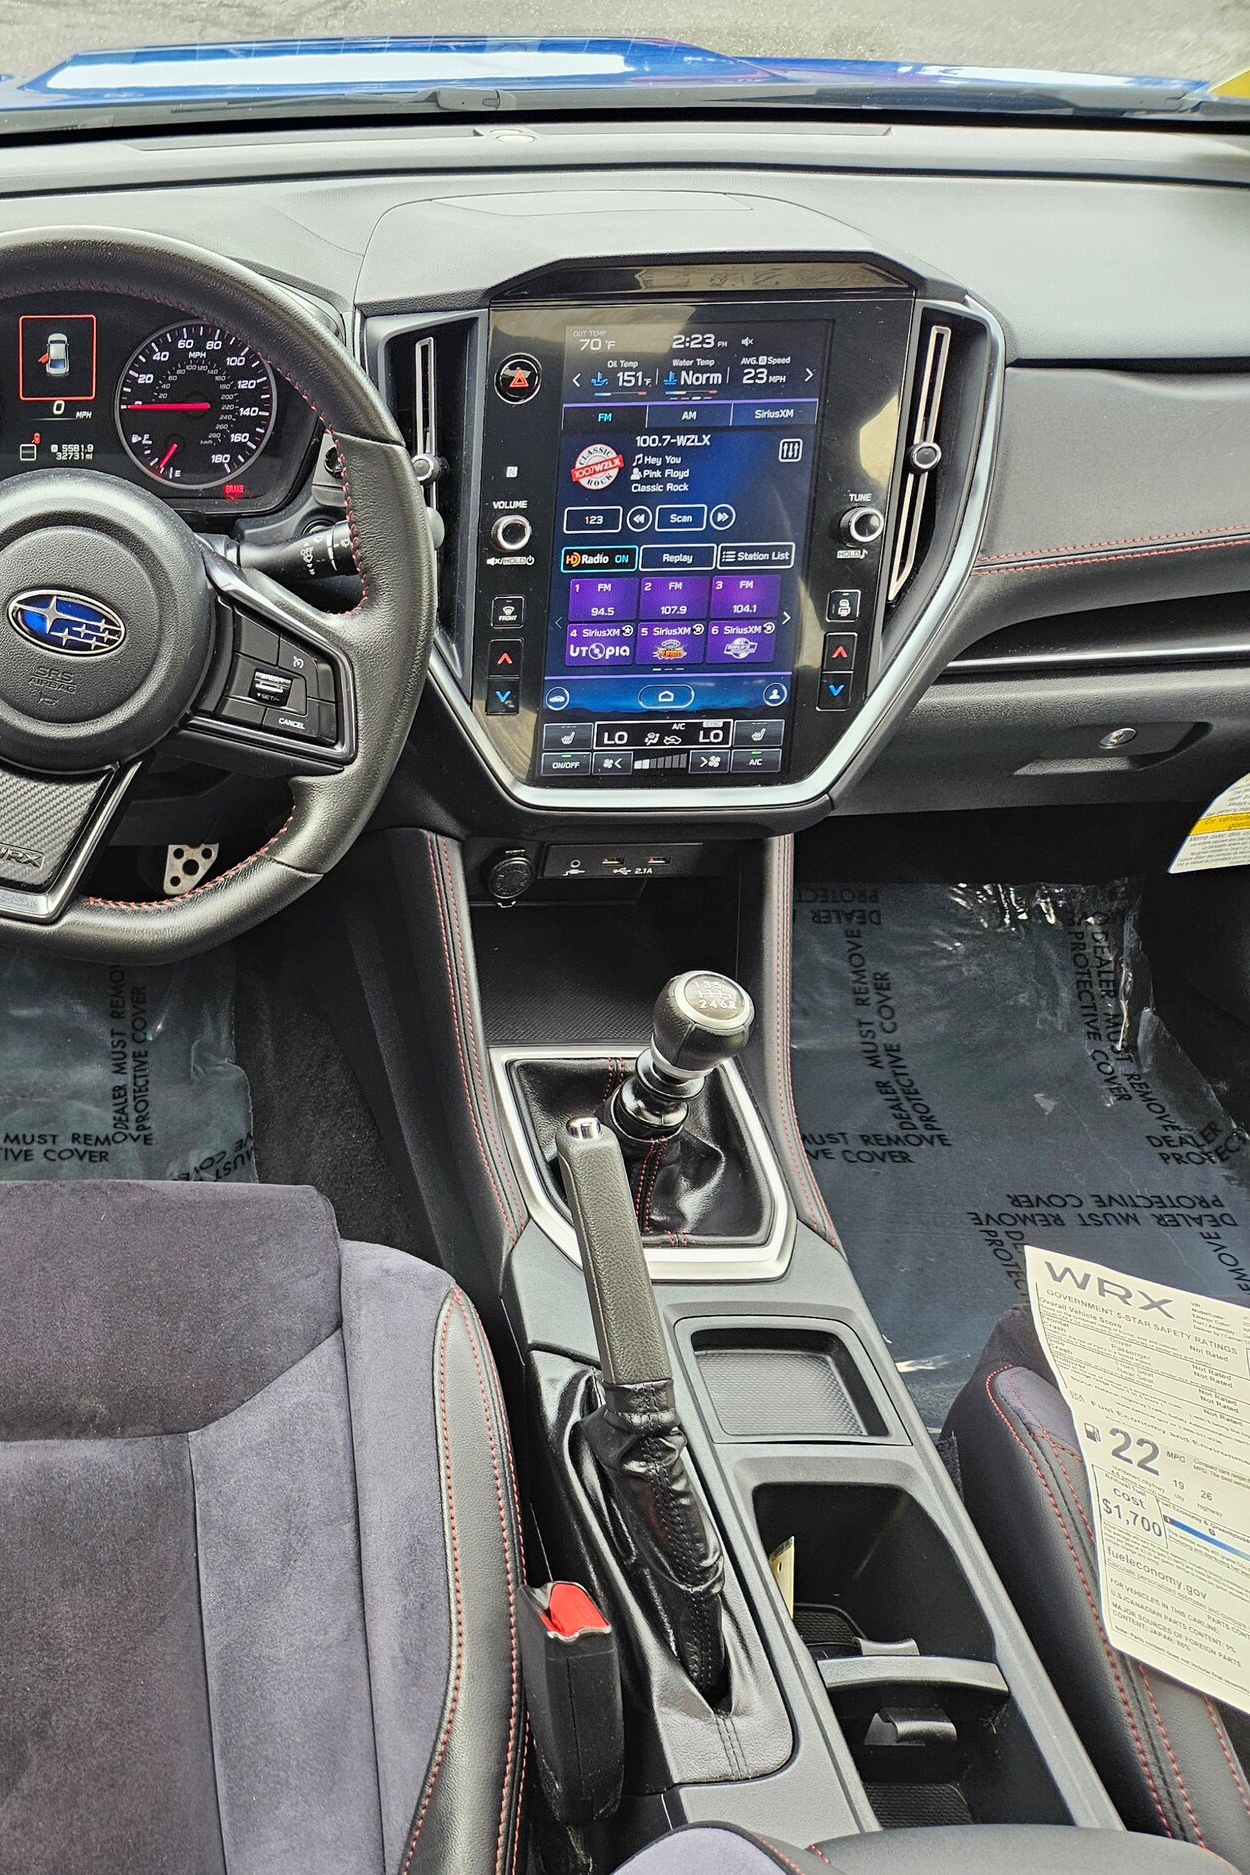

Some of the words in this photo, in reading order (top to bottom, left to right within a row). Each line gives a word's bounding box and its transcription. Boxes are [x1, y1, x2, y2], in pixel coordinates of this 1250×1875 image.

[178, 339, 194, 349] 60
[206, 341, 222, 350] 80
[580, 338, 602, 350] 70
[672, 334, 715, 348] 2:23
[152, 351, 169, 361] 40
[226, 356, 245, 366] 100
[696, 358, 715, 366] Temp
[768, 356, 790, 365] Speed
[607, 360, 618, 368] Oil
[620, 360, 638, 369] Temp
[138, 374, 154, 383] 20
[680, 370, 722, 386] Norm
[742, 368, 767, 384] 23
[237, 380, 256, 389] 120
[53, 400, 65, 414] 0
[239, 407, 259, 416] 140
[598, 413, 612, 422] FM
[682, 411, 697, 420] AM
[754, 409, 794, 418] SiriusXM
[230, 433, 250, 442] 160
[636, 434, 711, 447] 100.7-WZLX
[211, 454, 230, 463] 180
[579, 447, 613, 466] CLASSIC
[644, 456, 662, 466] Hey
[666, 456, 681, 464] You
[586, 474, 613, 486] ROCK
[643, 469, 662, 478] Pink
[665, 468, 690, 480] Floyd
[632, 484, 664, 492] Classic
[667, 482, 689, 492] Rock
[849, 494, 872, 502] TUNE
[492, 500, 528, 509] VOLUME
[584, 516, 604, 525] 123
[670, 514, 692, 523] Scan
[582, 554, 609, 564] Radio
[614, 554, 629, 563] ON
[662, 554, 693, 564] Replay
[738, 552, 770, 560] Station
[772, 551, 790, 560] List
[575, 584, 580, 592] 1
[598, 584, 612, 592] FM
[644, 582, 652, 591] 2
[668, 582, 682, 590] FM
[716, 581, 724, 590] 3
[740, 580, 754, 588] FM
[591, 608, 614, 616] 94.5
[660, 606, 687, 614] 107.9
[732, 604, 756, 613] 104.1
[570, 629, 578, 637] 4
[582, 628, 620, 637] SiriusXM
[641, 628, 648, 636] 5
[653, 627, 690, 636] SiriusXM
[712, 626, 718, 634] 6
[724, 626, 762, 634] SiriusXM
[36, 666, 74, 683] SRS
[28, 677, 76, 694] AIRBAG
[278, 718, 306, 730] CANCEL
[672, 722, 686, 730] A/C
[604, 730, 628, 745] LO
[698, 729, 724, 743] LO
[552, 761, 580, 770] ON/OFF
[749, 758, 762, 766] A/C
[634, 867, 652, 875] 2.1A
[811, 910, 882, 926] DEALER
[844, 928, 871, 1006] REMOVE
[870, 971, 898, 1034] COVER
[132, 985, 148, 1044] COVER
[1070, 931, 1102, 1041] PROTECTIVE
[1091, 1050, 1132, 1102] COVER
[1092, 931, 1118, 998] DEALER
[1124, 1072, 1182, 1132] REMOVE
[857, 1019, 884, 1070] MUST
[111, 1030, 128, 1075] MUST
[132, 1050, 150, 1132] PROTECTIVE
[884, 1043, 942, 1131] PROTECTIVE
[112, 1084, 130, 1130] DEALER
[875, 1080, 918, 1131] DEALER
[3, 1132, 59, 1146] MUST
[71, 1131, 154, 1146] REMOVE
[860, 1133, 952, 1147] REMOVE
[1146, 1121, 1224, 1148] DEALER
[43, 1149, 110, 1163] COVER
[842, 1150, 915, 1164] COVER
[1006, 1194, 1084, 1208] COVER
[1095, 1194, 1225, 1210] PROTECTIVE
[968, 1212, 1066, 1226] REMOVE
[1079, 1212, 1140, 1226] MUST
[1152, 1213, 1238, 1227] DEALER
[1044, 1260, 1177, 1321] WRX
[1068, 1306, 1097, 1320] Vehicle
[1046, 1289, 1113, 1316] GOVERNMENT
[1116, 1312, 1152, 1329] 5-STAR
[1154, 1324, 1191, 1340] SAFETY
[1194, 1336, 1238, 1355] RATINGS
[1109, 1427, 1160, 1476] 22
[1166, 1450, 1186, 1464] MPG
[1173, 1480, 1184, 1490] 19
[1114, 1488, 1146, 1510] cost
[1200, 1490, 1212, 1501] 26
[1102, 1498, 1162, 1538] $1,700
[1107, 1546, 1208, 1600] fueleconomy.gov
[1125, 1584, 1160, 1606] VEHICLES
